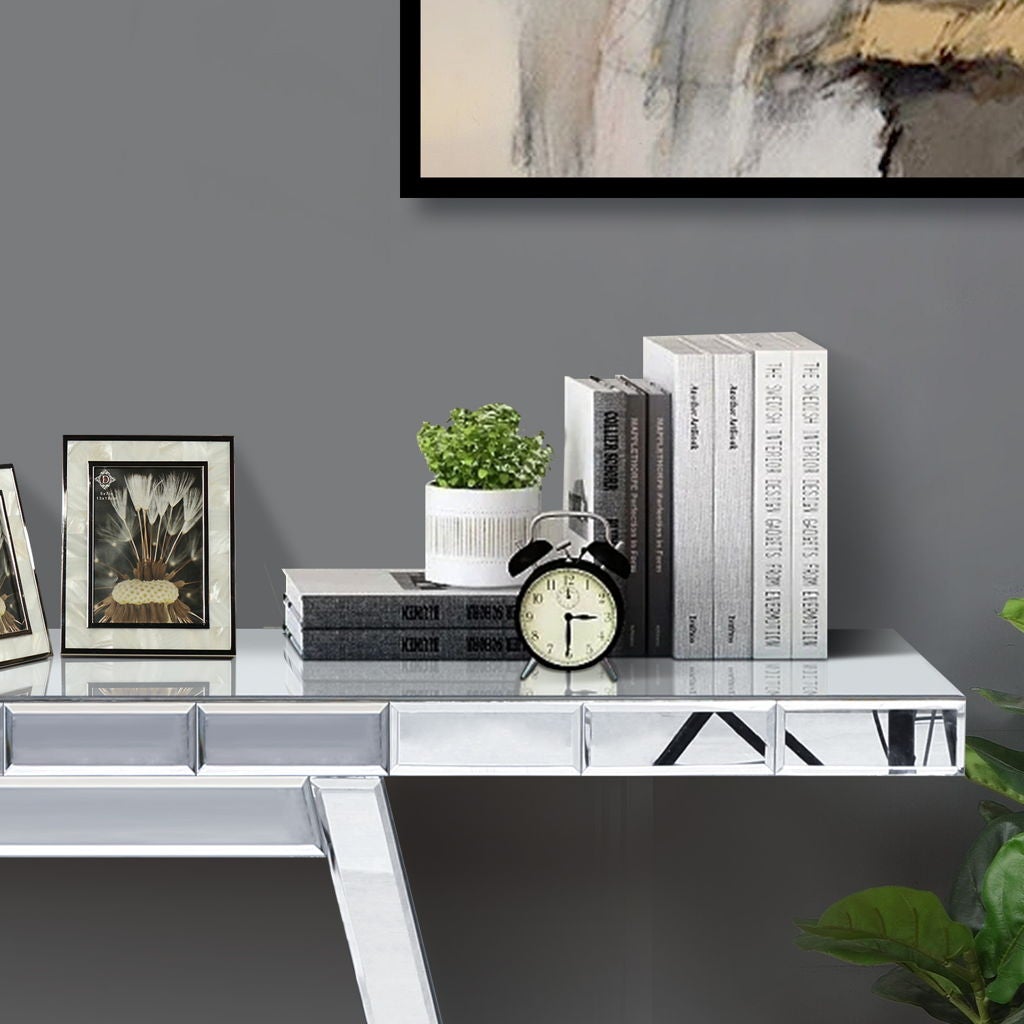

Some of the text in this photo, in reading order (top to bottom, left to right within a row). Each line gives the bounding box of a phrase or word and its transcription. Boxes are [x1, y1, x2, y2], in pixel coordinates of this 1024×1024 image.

[765, 362, 783, 379] THE
[802, 362, 820, 379] THE
[765, 430, 783, 474] INTERIOR
[802, 430, 820, 474] INTERIOR
[765, 479, 783, 513] DESIGN
[802, 479, 820, 513] DESIGN
[546, 579, 556, 590] 11
[564, 575, 575, 586] 12
[585, 579, 590, 590] 1
[532, 593, 544, 604] 10
[598, 593, 606, 604] 2
[525, 611, 533, 623] 9
[604, 612, 612, 623] 3
[531, 630, 540, 641] 8
[597, 632, 605, 641] 4
[546, 643, 554, 654] 7
